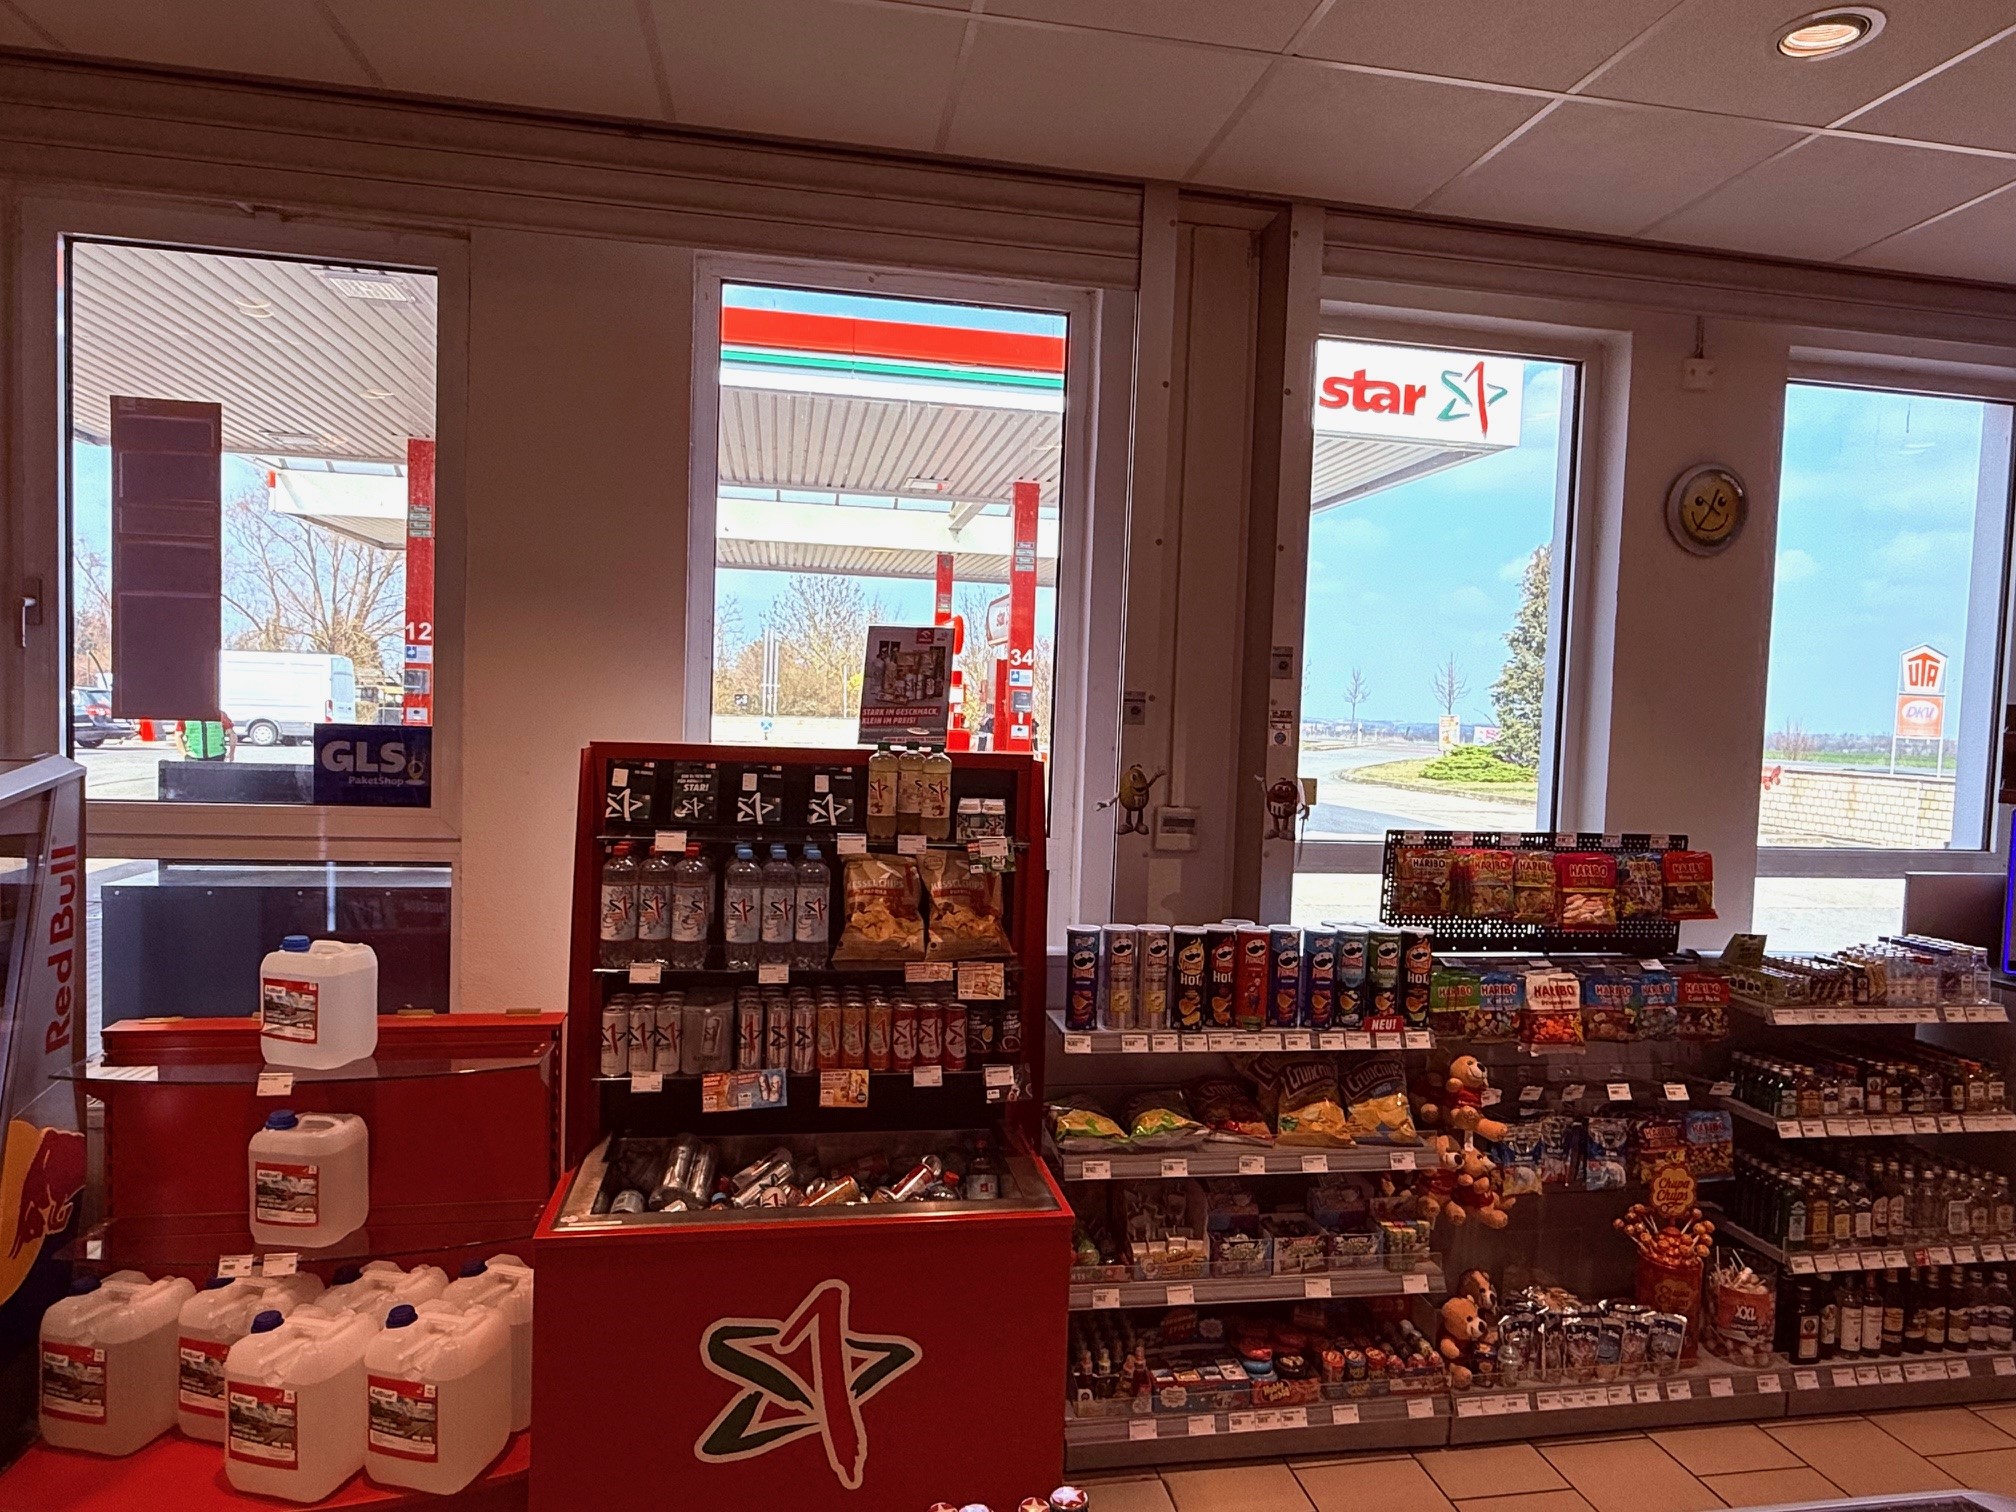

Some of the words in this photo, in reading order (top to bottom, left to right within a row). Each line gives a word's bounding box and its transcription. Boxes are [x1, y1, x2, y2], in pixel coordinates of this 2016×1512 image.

[1319, 369, 1427, 416] star
[405, 622, 432, 641] 12
[1010, 649, 1035, 666] 34
[1907, 652, 1941, 687] UTA
[862, 708, 885, 716] STARK
[886, 708, 895, 716] IM
[861, 717, 882, 725] KLEIN
[883, 717, 892, 725] IM
[893, 717, 917, 725] PREIS!
[322, 740, 406, 773] GLS
[348, 776, 404, 787] PaketShop
[683, 783, 710, 792] STAR!
[1413, 858, 1446, 868] HARIBO
[1672, 862, 1706, 874] HARIBO
[1569, 864, 1608, 878] HARIBO
[49, 843, 77, 946] Bull
[1180, 973, 1202, 985] HOT
[1213, 971, 1233, 983] HOT
[1438, 984, 1473, 998] HARIBO
[1480, 983, 1518, 996] HARIBO
[1533, 984, 1575, 998] HARIBO
[1595, 984, 1633, 997] HARIBO
[1641, 984, 1671, 996] HARIBO
[1685, 983, 1721, 995] HARIBO
[45, 948, 74, 1055] Red
[1371, 1018, 1397, 1030] NEU!
[1346, 1062, 1401, 1092] Crunchips
[1658, 1176, 1690, 1191] Chupa
[1656, 1188, 1688, 1202] Chups
[1735, 1304, 1757, 1321] XXL
